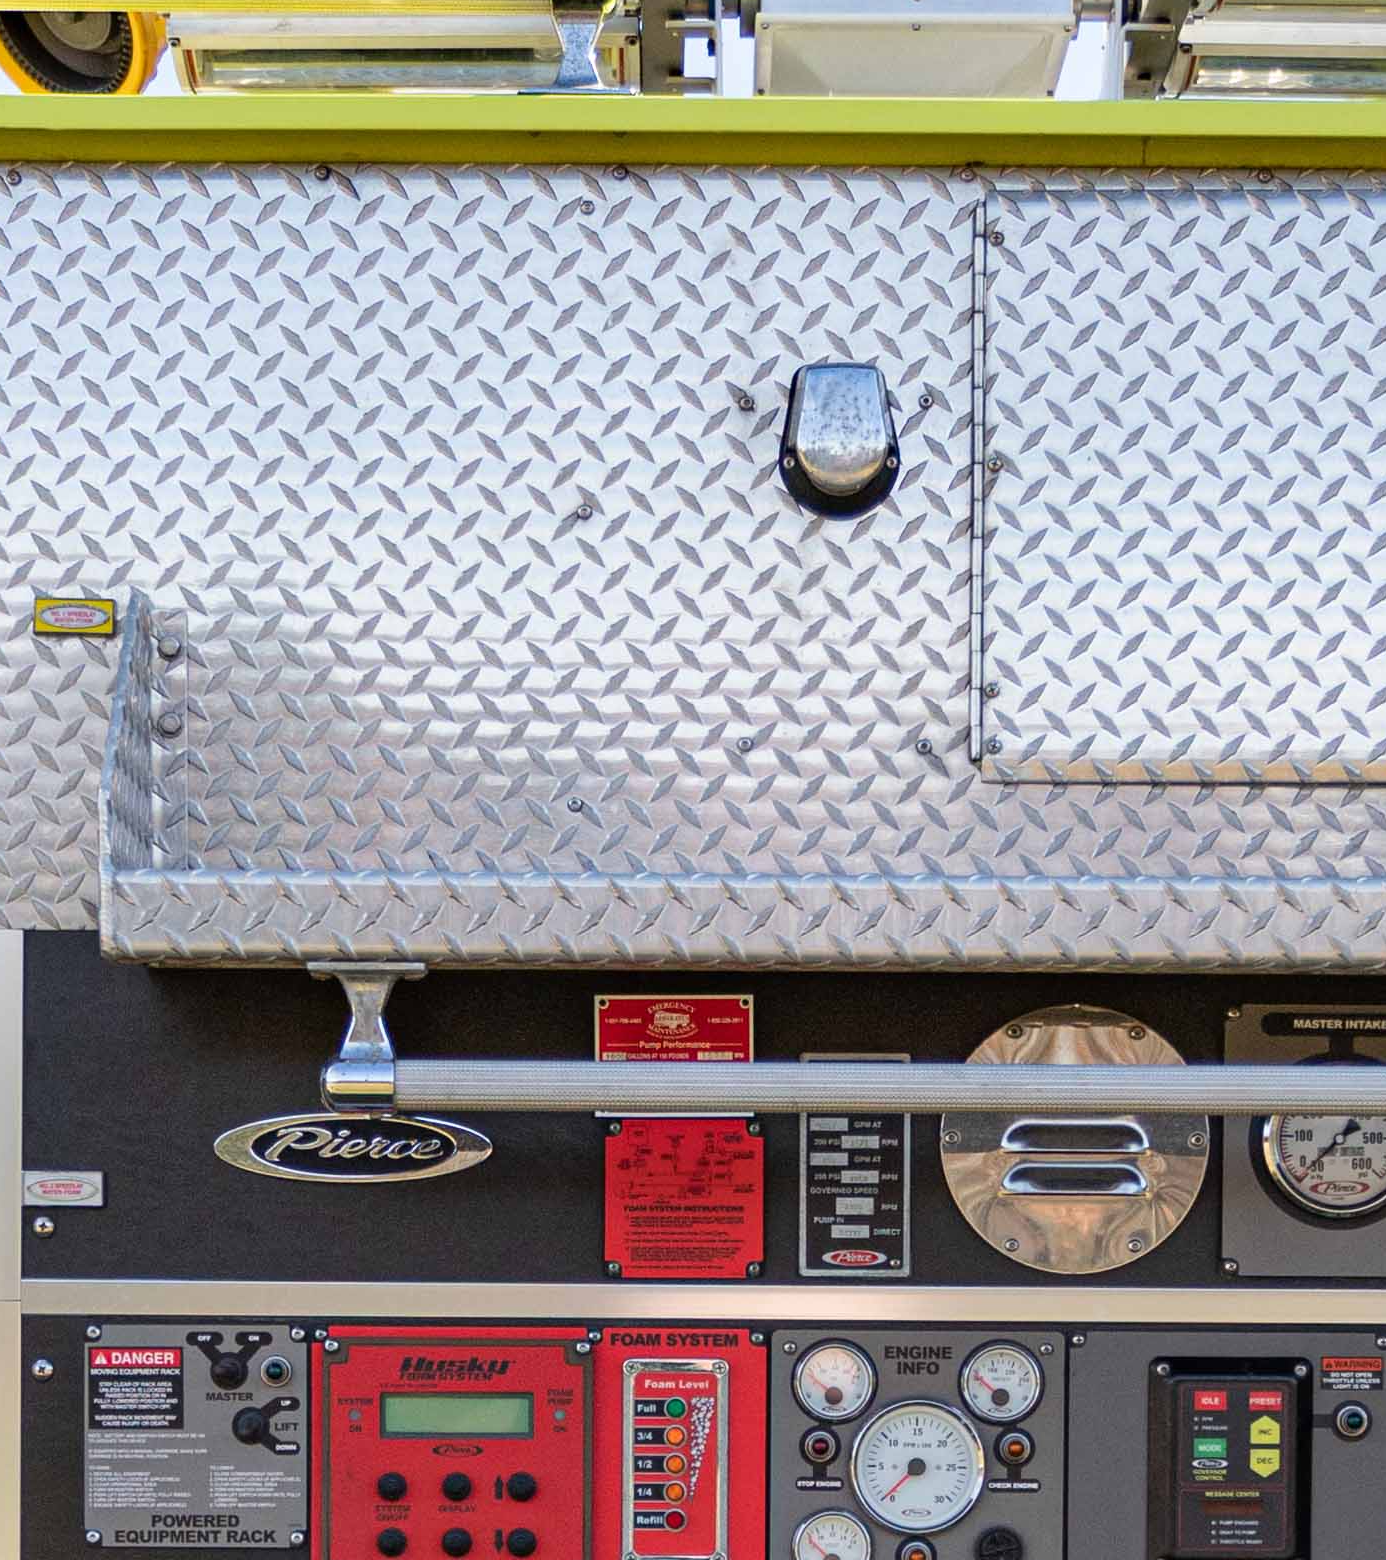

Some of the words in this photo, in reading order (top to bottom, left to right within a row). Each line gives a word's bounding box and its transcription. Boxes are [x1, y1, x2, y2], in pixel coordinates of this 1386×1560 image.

[1293, 1019, 1343, 1030] MASTER
[1294, 1130, 1313, 1143] 100
[1362, 1132, 1384, 1144] 500
[265, 1128, 446, 1163] Pierce
[1351, 1158, 1372, 1171] 600
[611, 1334, 661, 1346] FOAM
[667, 1334, 738, 1347] SYSTEM
[884, 1346, 953, 1359] ENGINE
[111, 1352, 174, 1365] DANGER
[400, 1357, 512, 1375] Husky
[897, 1362, 939, 1375] INFO
[1333, 1360, 1381, 1369] WARNING
[645, 1380, 676, 1388] Foam
[679, 1380, 709, 1388] Level
[205, 1392, 253, 1401] MASTER
[1201, 1397, 1220, 1406] IDLE
[1249, 1397, 1281, 1406] PRESET
[637, 1404, 656, 1412] Full
[274, 1423, 298, 1431] LIFT
[637, 1432, 653, 1441] 3/4
[913, 1428, 923, 1436] 15
[1257, 1428, 1273, 1436] INC
[889, 1439, 899, 1447] 10
[937, 1440, 947, 1448] 20
[1198, 1444, 1221, 1452] MODE
[637, 1460, 652, 1469] 1/2
[946, 1464, 957, 1472] 25
[797, 1480, 814, 1488] STOP
[637, 1488, 652, 1496] 1/4
[151, 1515, 239, 1527] POWERED
[637, 1516, 663, 1524] Refill
[114, 1530, 221, 1543] EQUIPMENT
[226, 1530, 277, 1543] RACK
